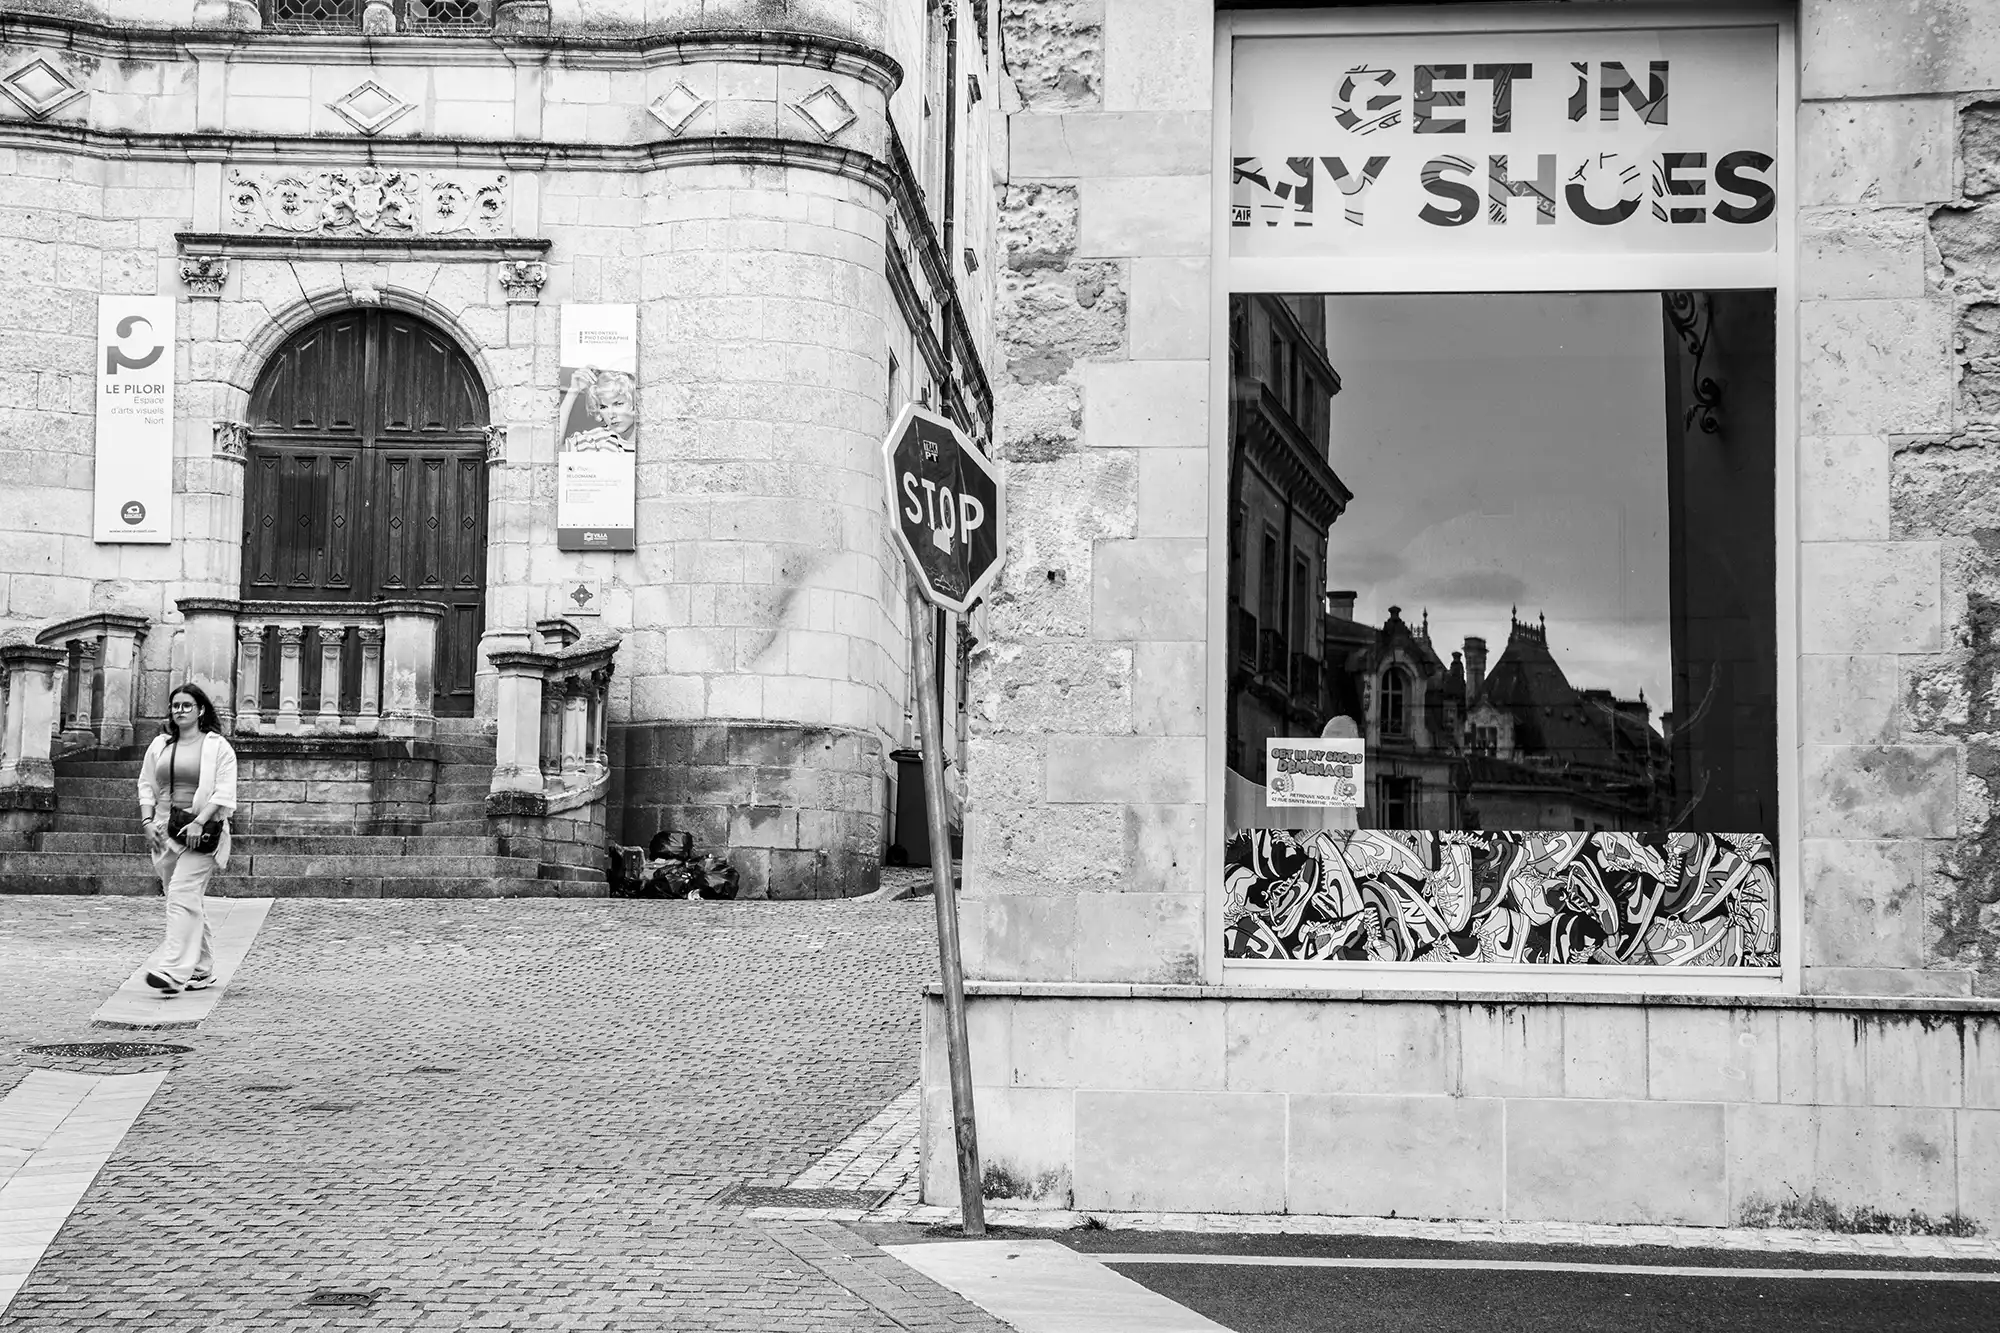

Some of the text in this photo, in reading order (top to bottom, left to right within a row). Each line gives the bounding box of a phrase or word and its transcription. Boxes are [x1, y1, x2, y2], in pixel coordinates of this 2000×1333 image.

[1331, 60, 1670, 136] GET IN
[1231, 150, 1777, 228] MY SHOES
[105, 384, 165, 394] LE PILORI
[133, 396, 165, 405] Espace
[144, 417, 164, 425] Niort
[925, 451, 938, 462] PT
[903, 471, 984, 544] STOP
[1271, 748, 1363, 764] GET IN MY SHOES
